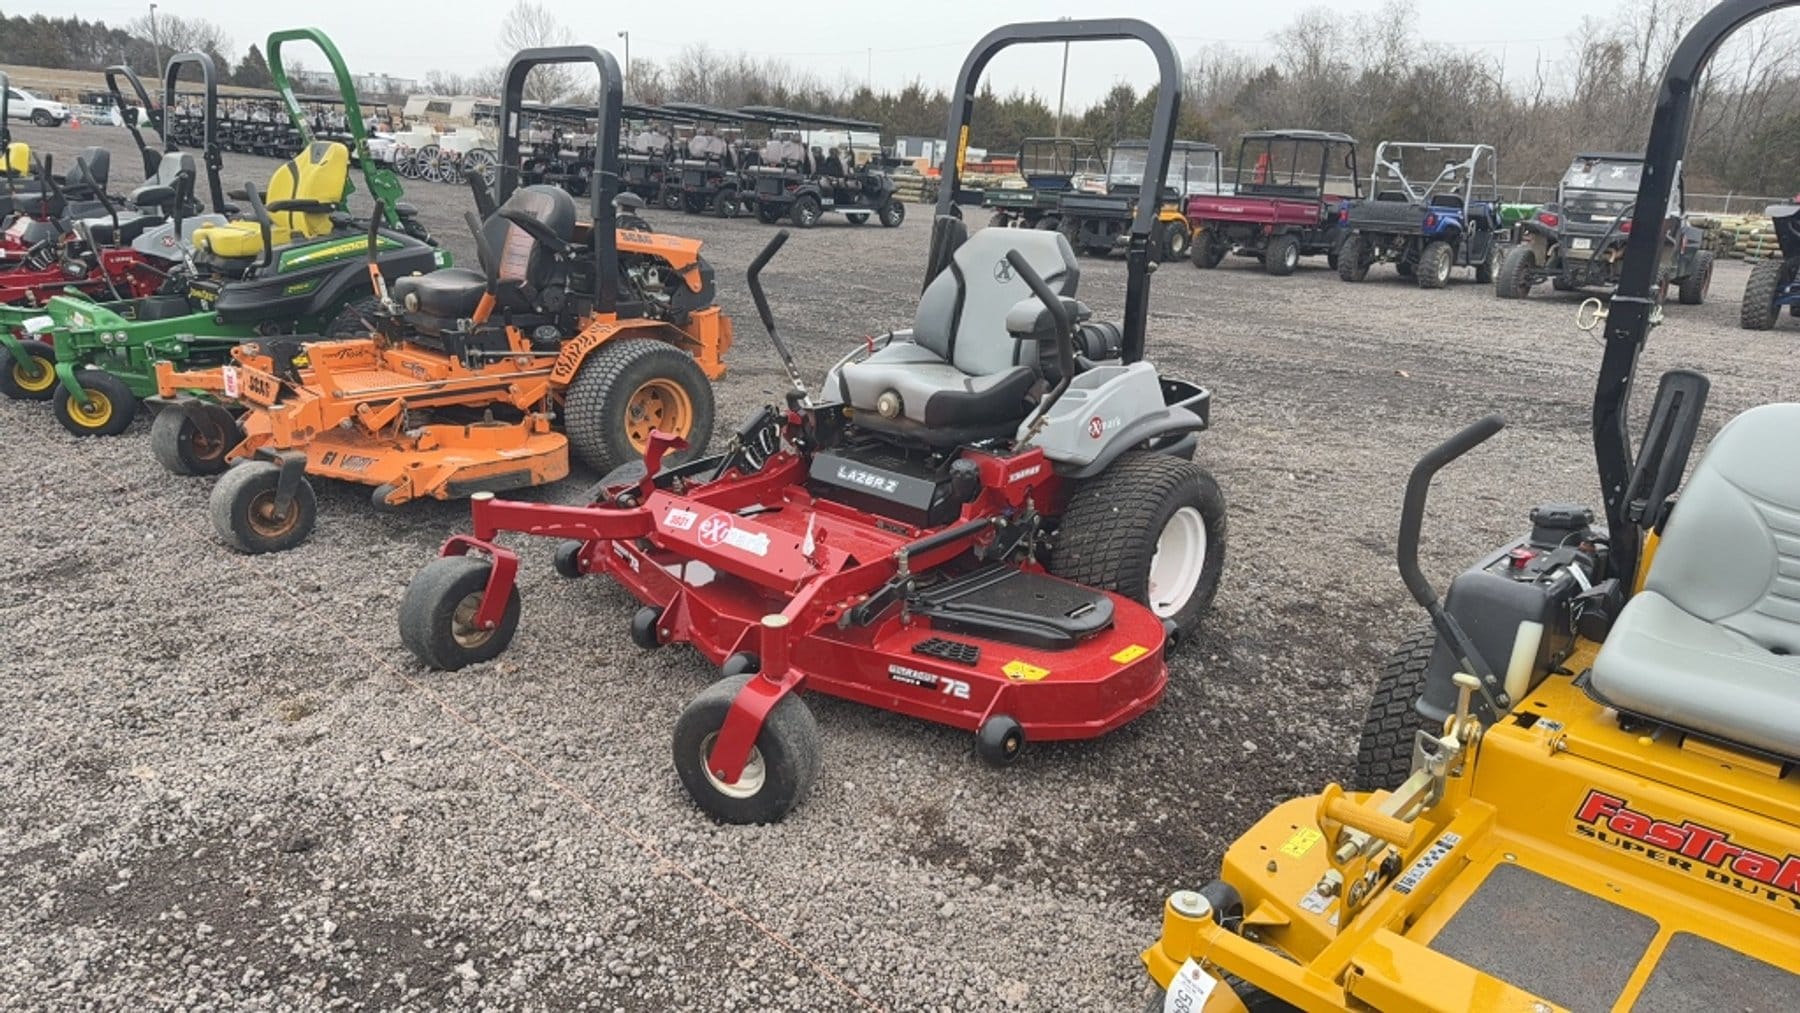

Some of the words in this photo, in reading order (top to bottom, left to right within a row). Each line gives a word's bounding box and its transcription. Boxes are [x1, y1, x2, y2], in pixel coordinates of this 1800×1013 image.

[837, 464, 885, 489] LAZER
[940, 676, 971, 701] 72
[1576, 824, 1693, 872] SUPER
[1705, 869, 1800, 911] DUTY
